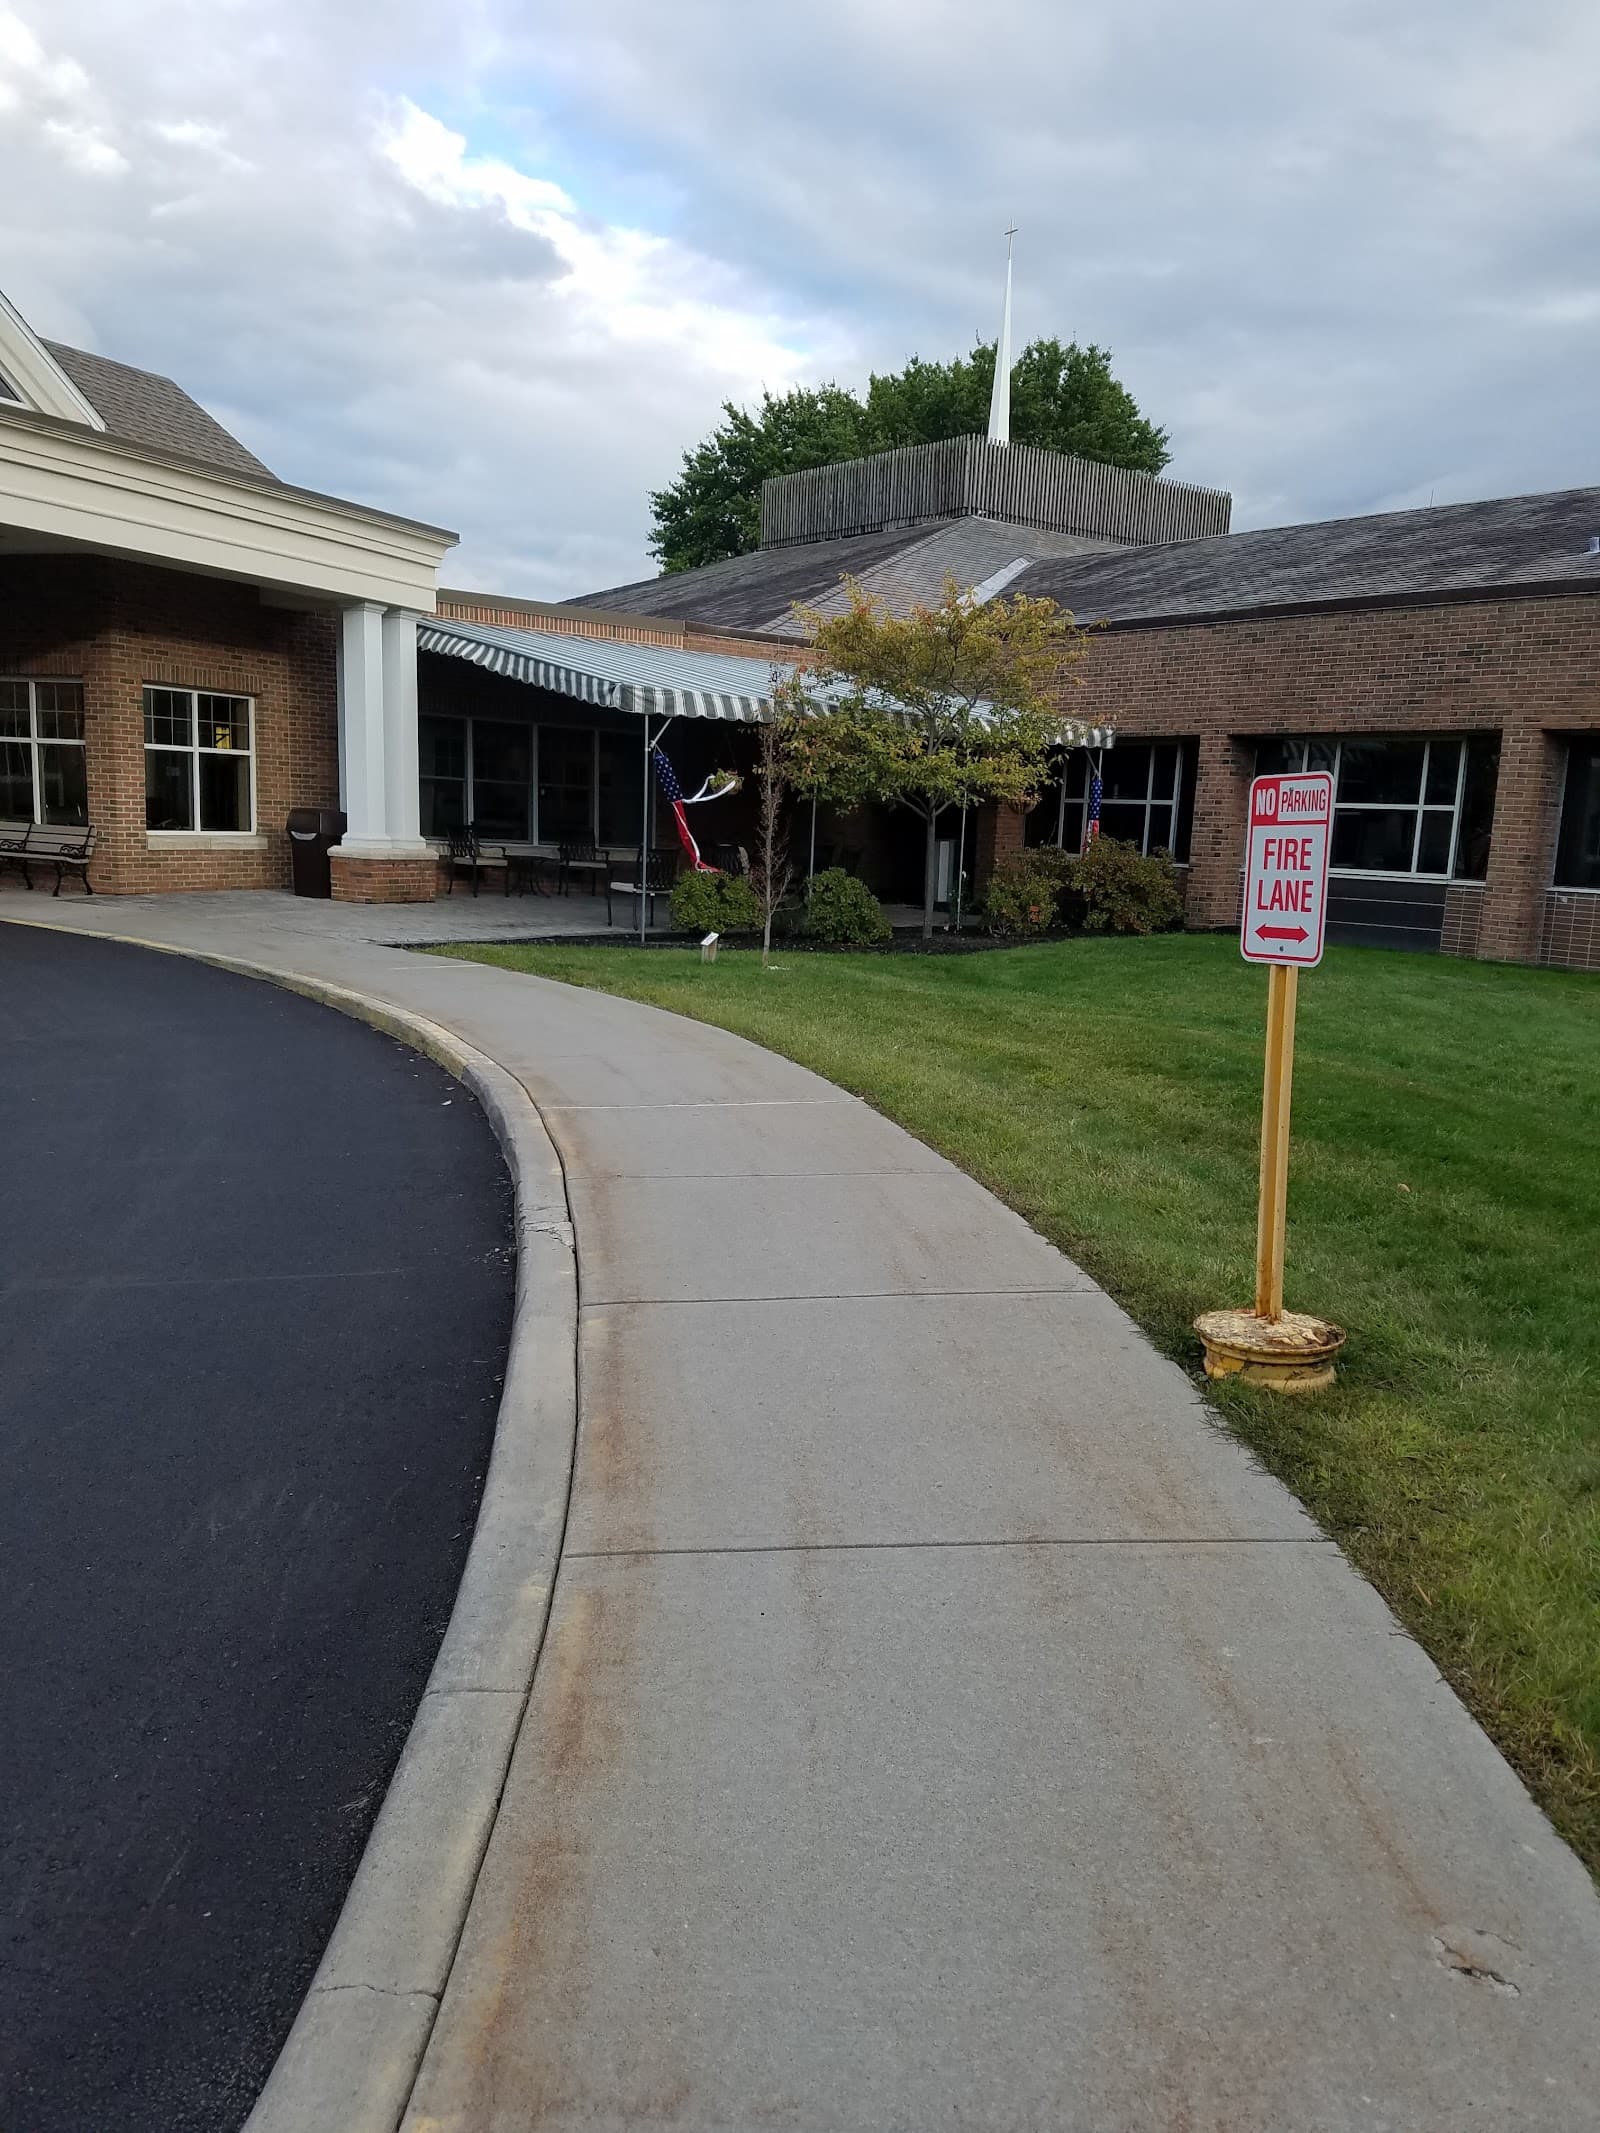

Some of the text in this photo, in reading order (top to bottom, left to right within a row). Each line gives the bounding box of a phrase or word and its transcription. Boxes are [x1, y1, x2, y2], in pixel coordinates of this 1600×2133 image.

[1255, 788, 1326, 816] NO PARKING
[1263, 838, 1313, 870] FIRE
[1257, 879, 1314, 912] LANE
